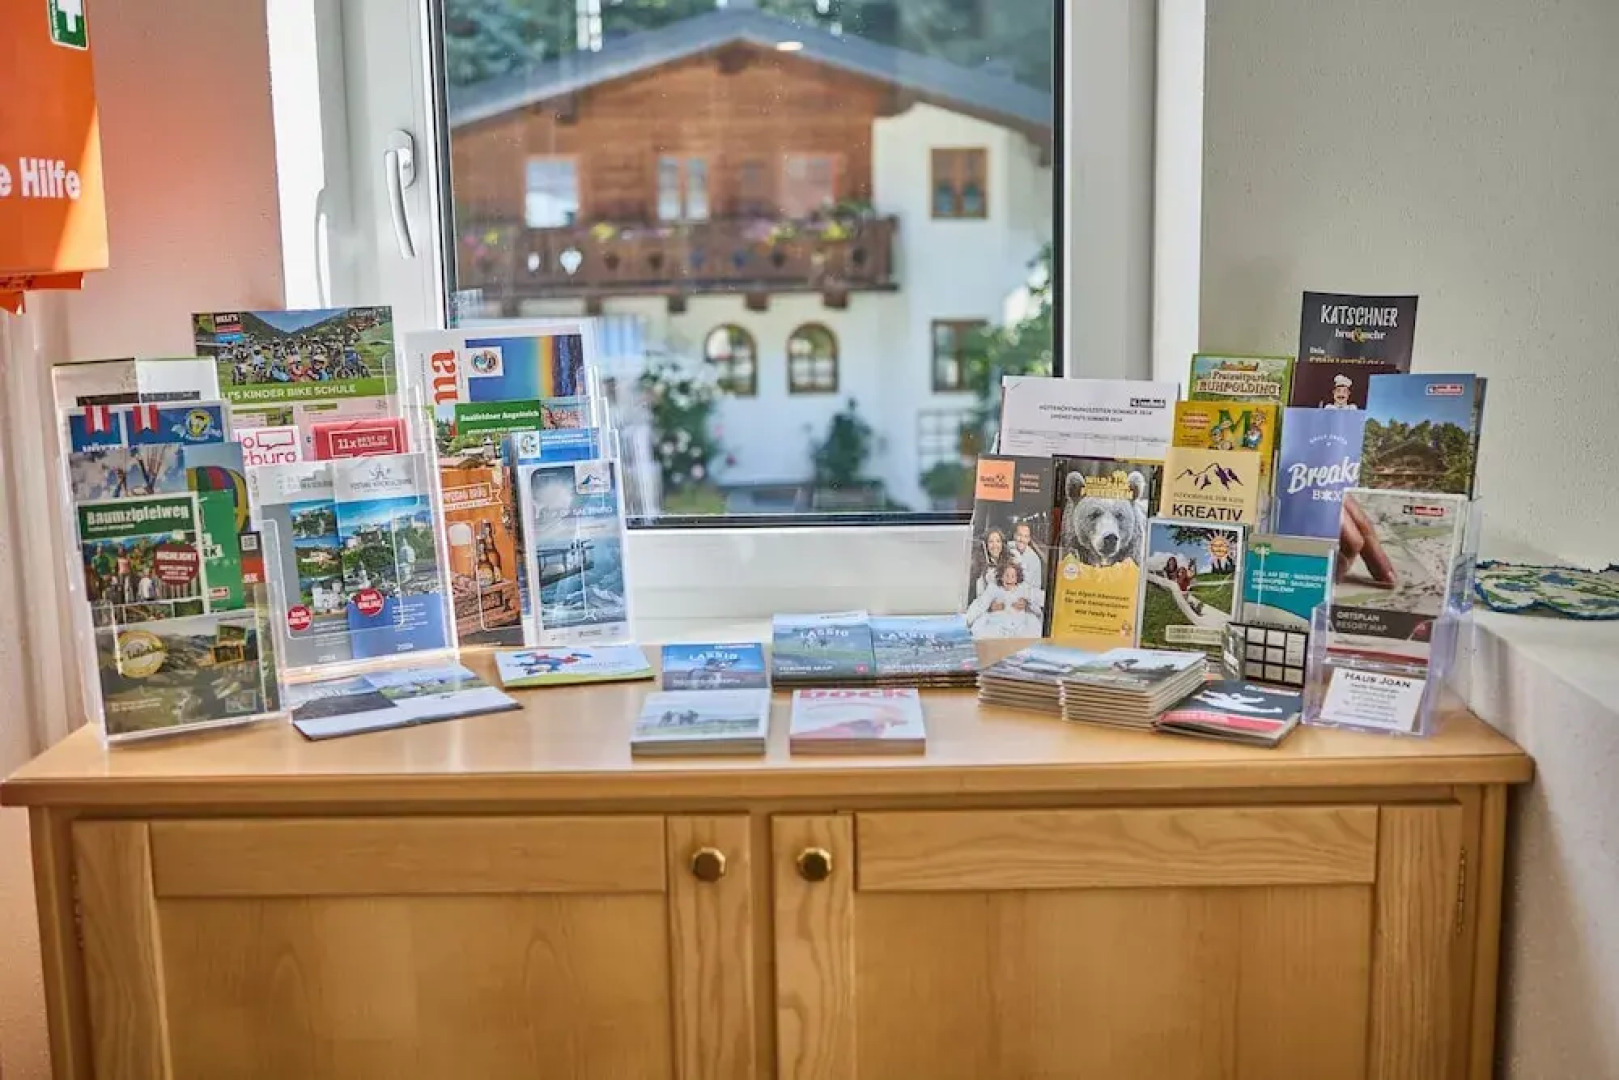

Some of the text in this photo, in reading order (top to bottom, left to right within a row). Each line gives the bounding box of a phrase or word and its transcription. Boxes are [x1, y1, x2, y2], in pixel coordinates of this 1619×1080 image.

[19, 157, 81, 199] Hilfe
[1320, 304, 1398, 327] KATSCHNER
[1172, 504, 1243, 521] KREATIV
